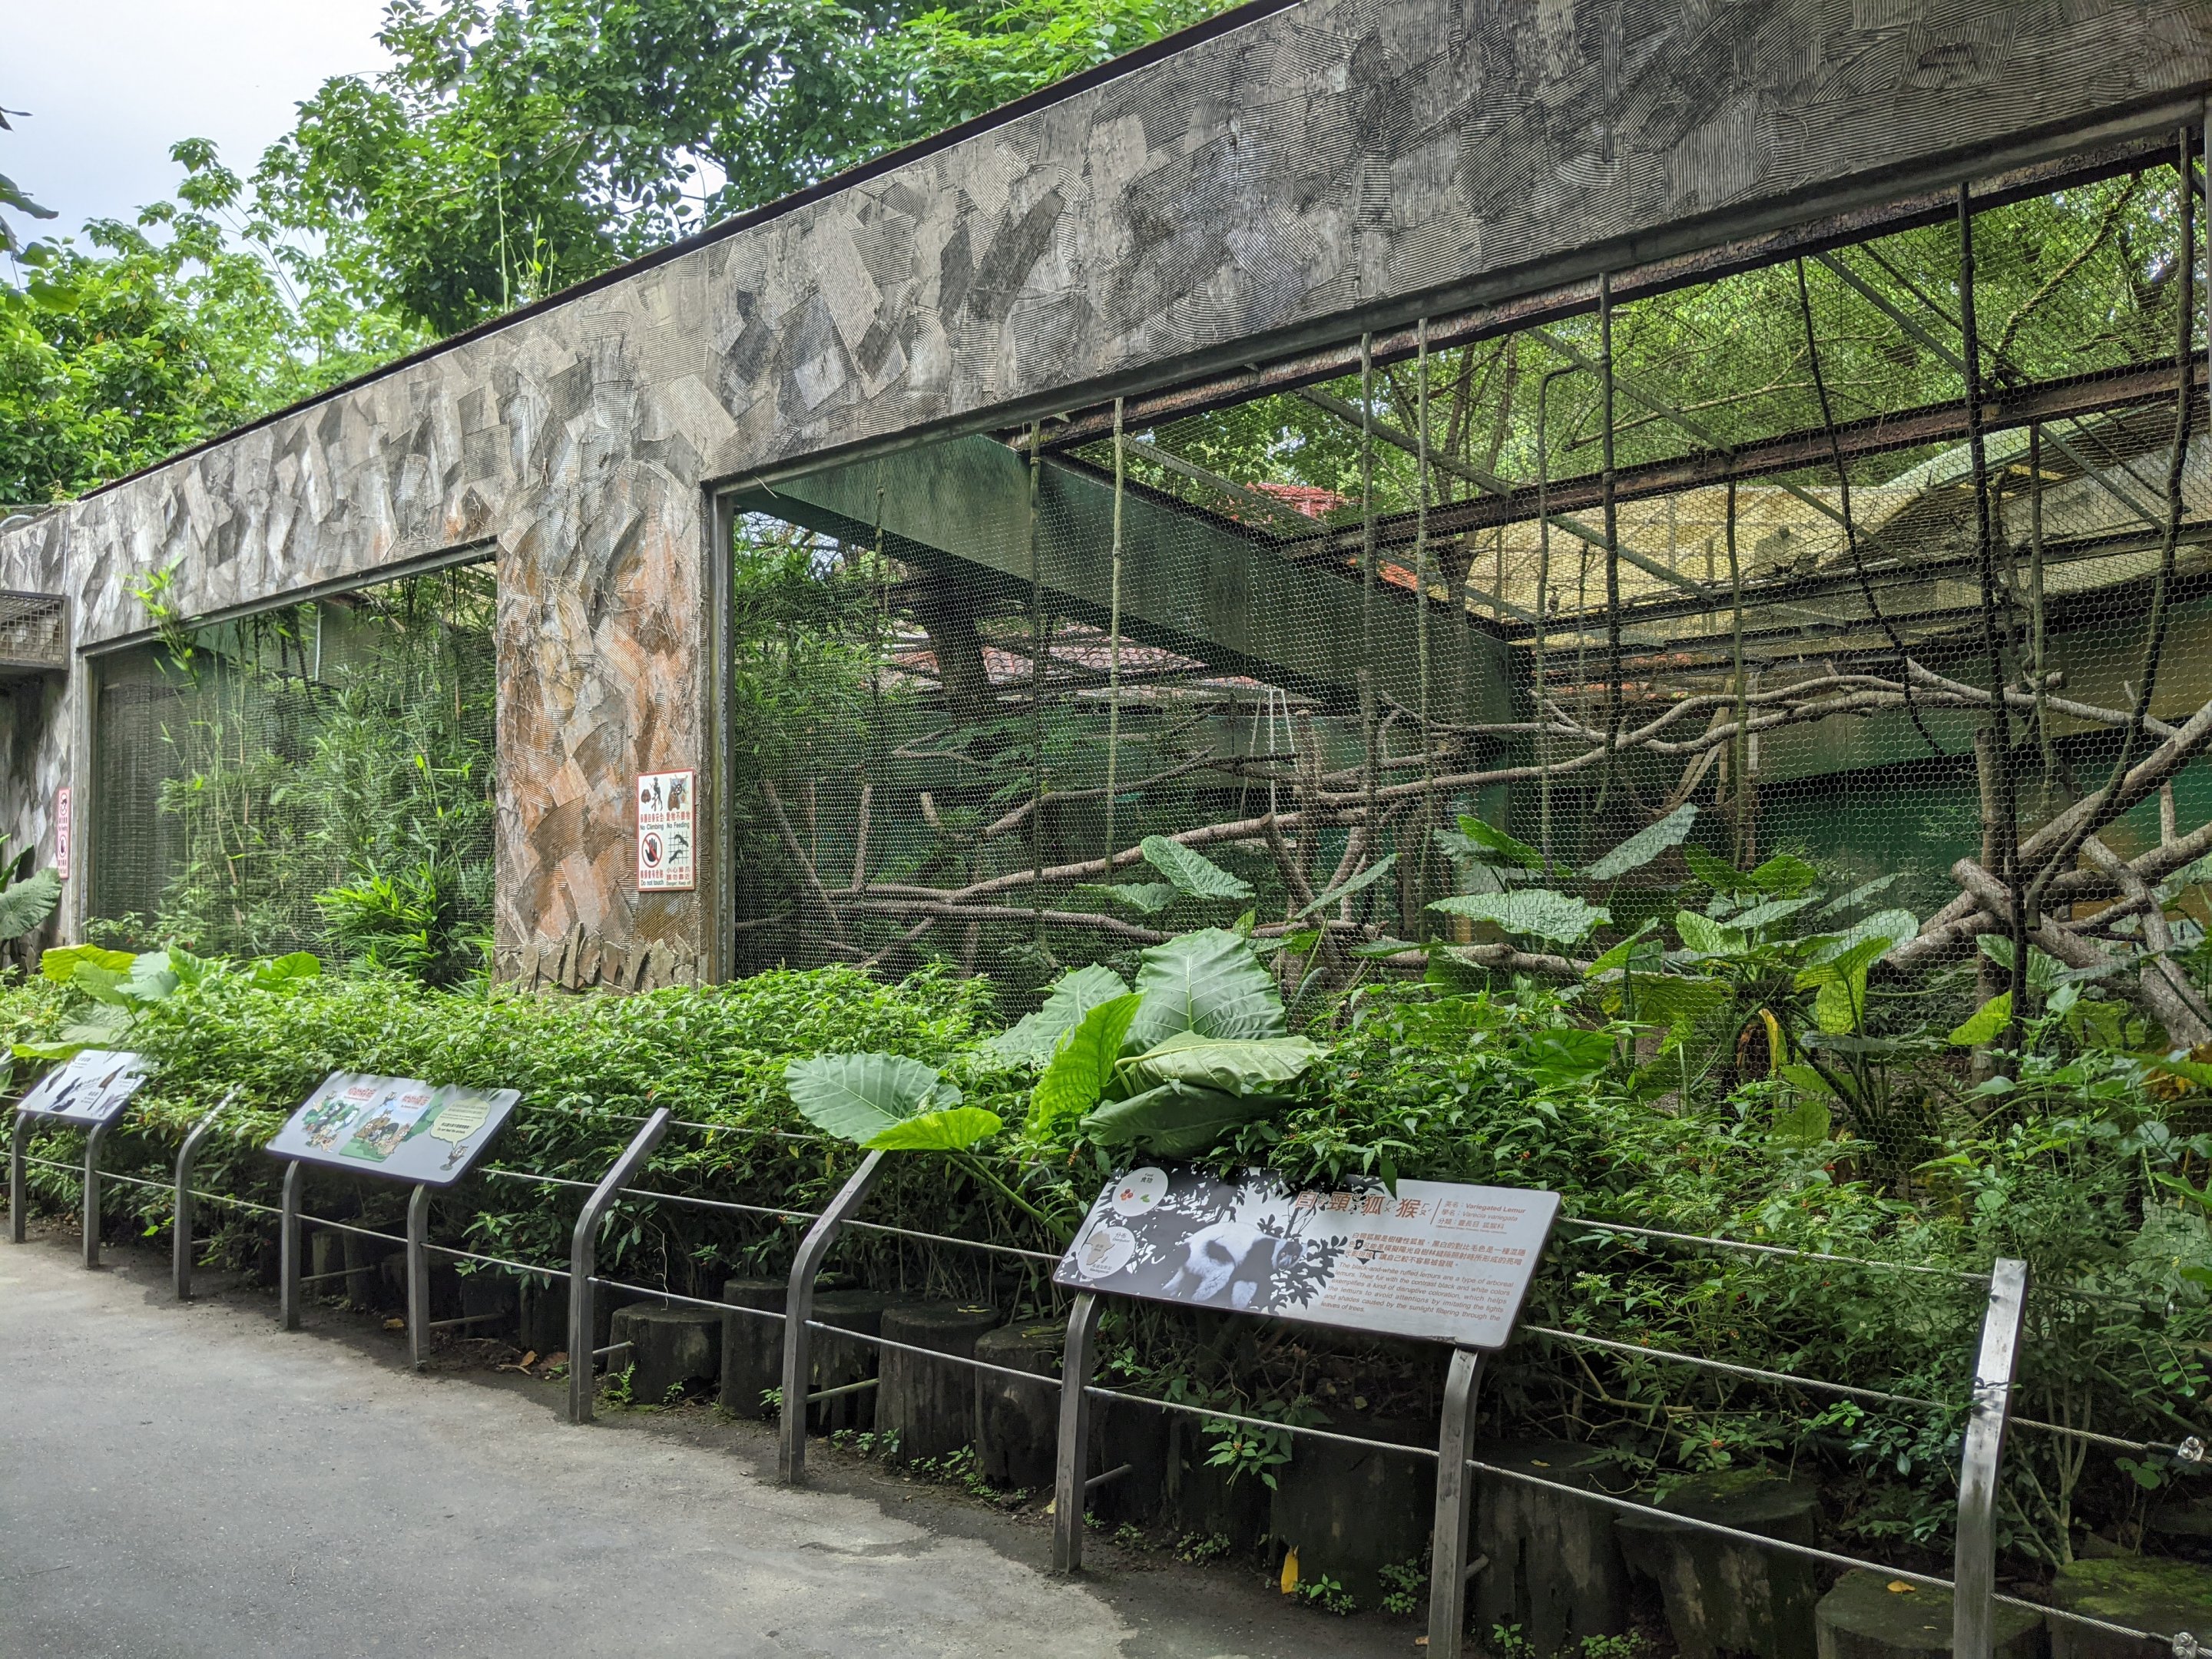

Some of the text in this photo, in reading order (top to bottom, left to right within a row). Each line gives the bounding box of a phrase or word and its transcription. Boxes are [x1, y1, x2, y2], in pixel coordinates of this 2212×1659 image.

[1294, 1189, 1421, 1218] 白頸狐猴
[1466, 1203, 1502, 1212] Variegated
[1488, 1214, 1518, 1222] variegata
[1352, 1265, 1399, 1274] black-and-white
[1331, 1279, 1365, 1287] exemplifies
[1396, 1286, 1427, 1294] disruptive
[1428, 1290, 1461, 1299] coloration,
[1411, 1279, 1437, 1287] contrast
[1395, 1295, 1428, 1303] attentions
[1443, 1300, 1471, 1310] imitating
[1486, 1305, 1504, 1313] lights
[1409, 1305, 1434, 1313] sunlight
[1435, 1307, 1460, 1316] filtering
[1462, 1311, 1487, 1320] through
